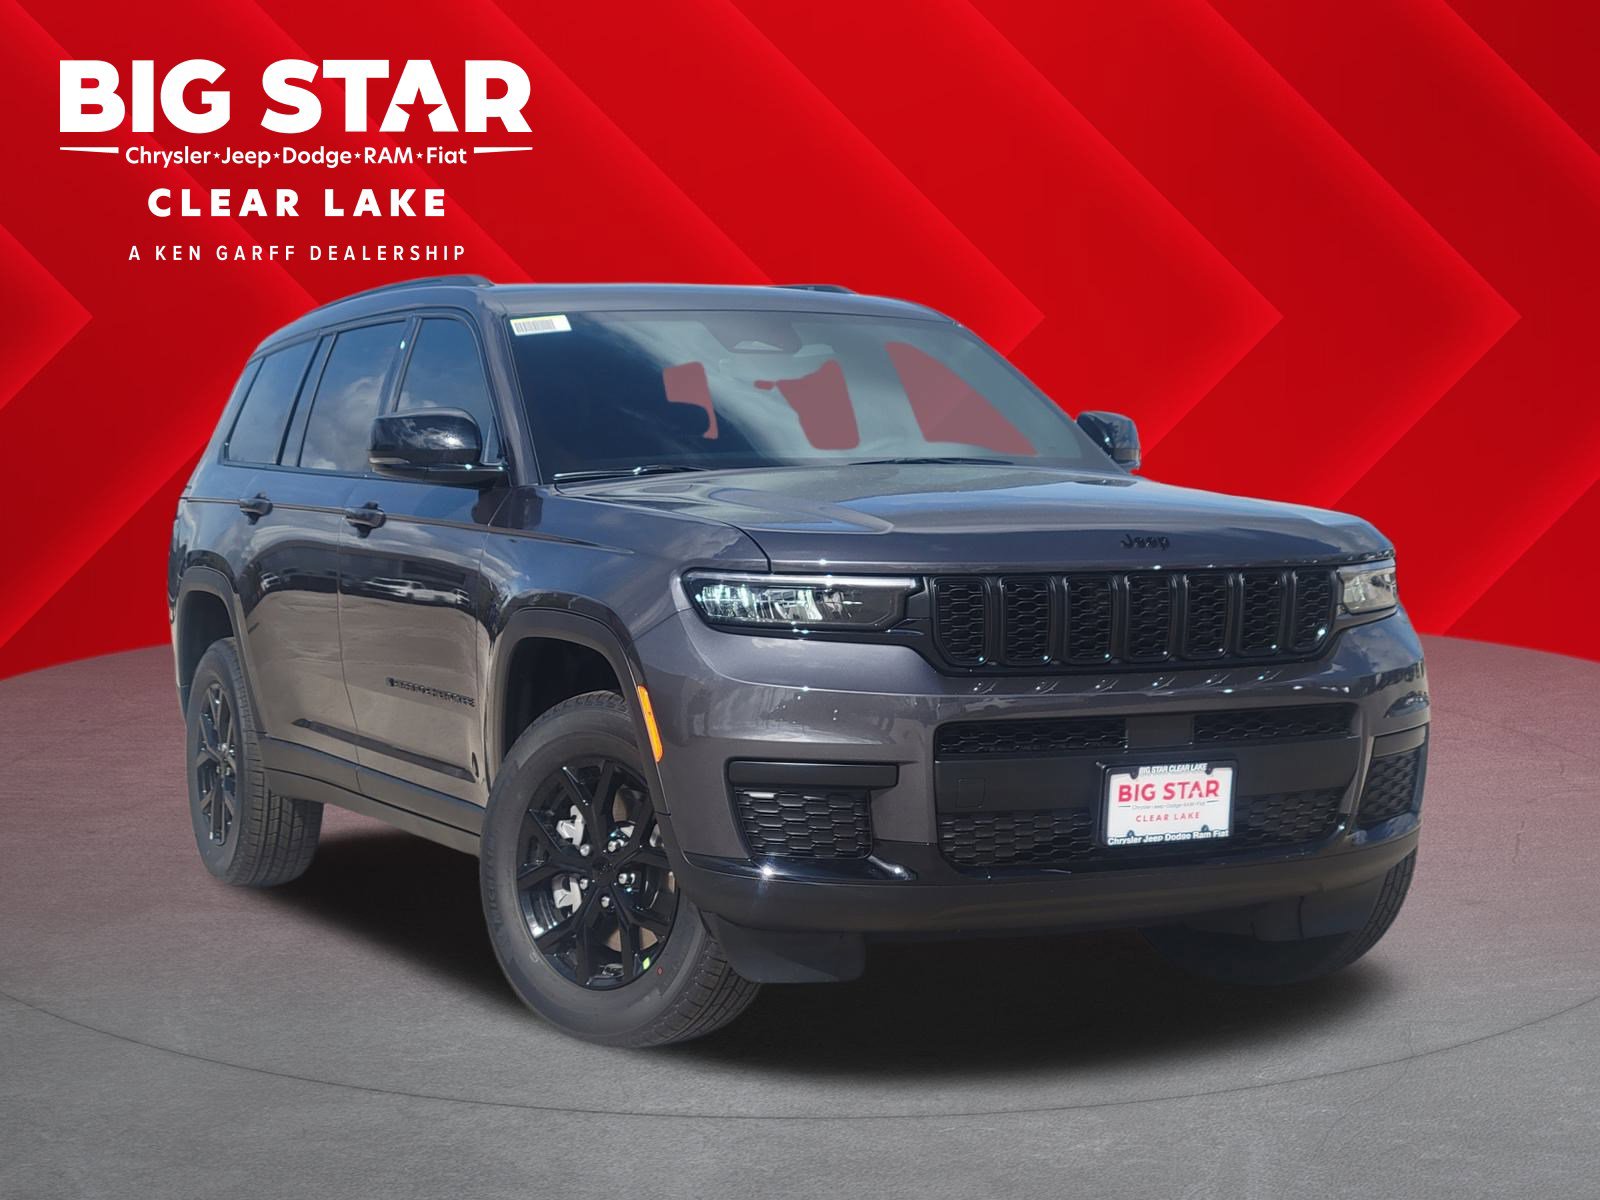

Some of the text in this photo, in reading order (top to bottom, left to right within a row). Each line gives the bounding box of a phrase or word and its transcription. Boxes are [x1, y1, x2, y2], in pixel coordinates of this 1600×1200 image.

[1120, 534, 1169, 551] Jeep
[1169, 764, 1190, 772] CLEAR
[1191, 763, 1208, 771] LAKE
[1118, 780, 1219, 802] BIG STAR
[1136, 812, 1200, 822] CLEAR LAKE
[1108, 829, 1229, 845] Chrysler Jeep Dodge Ram Fiat
